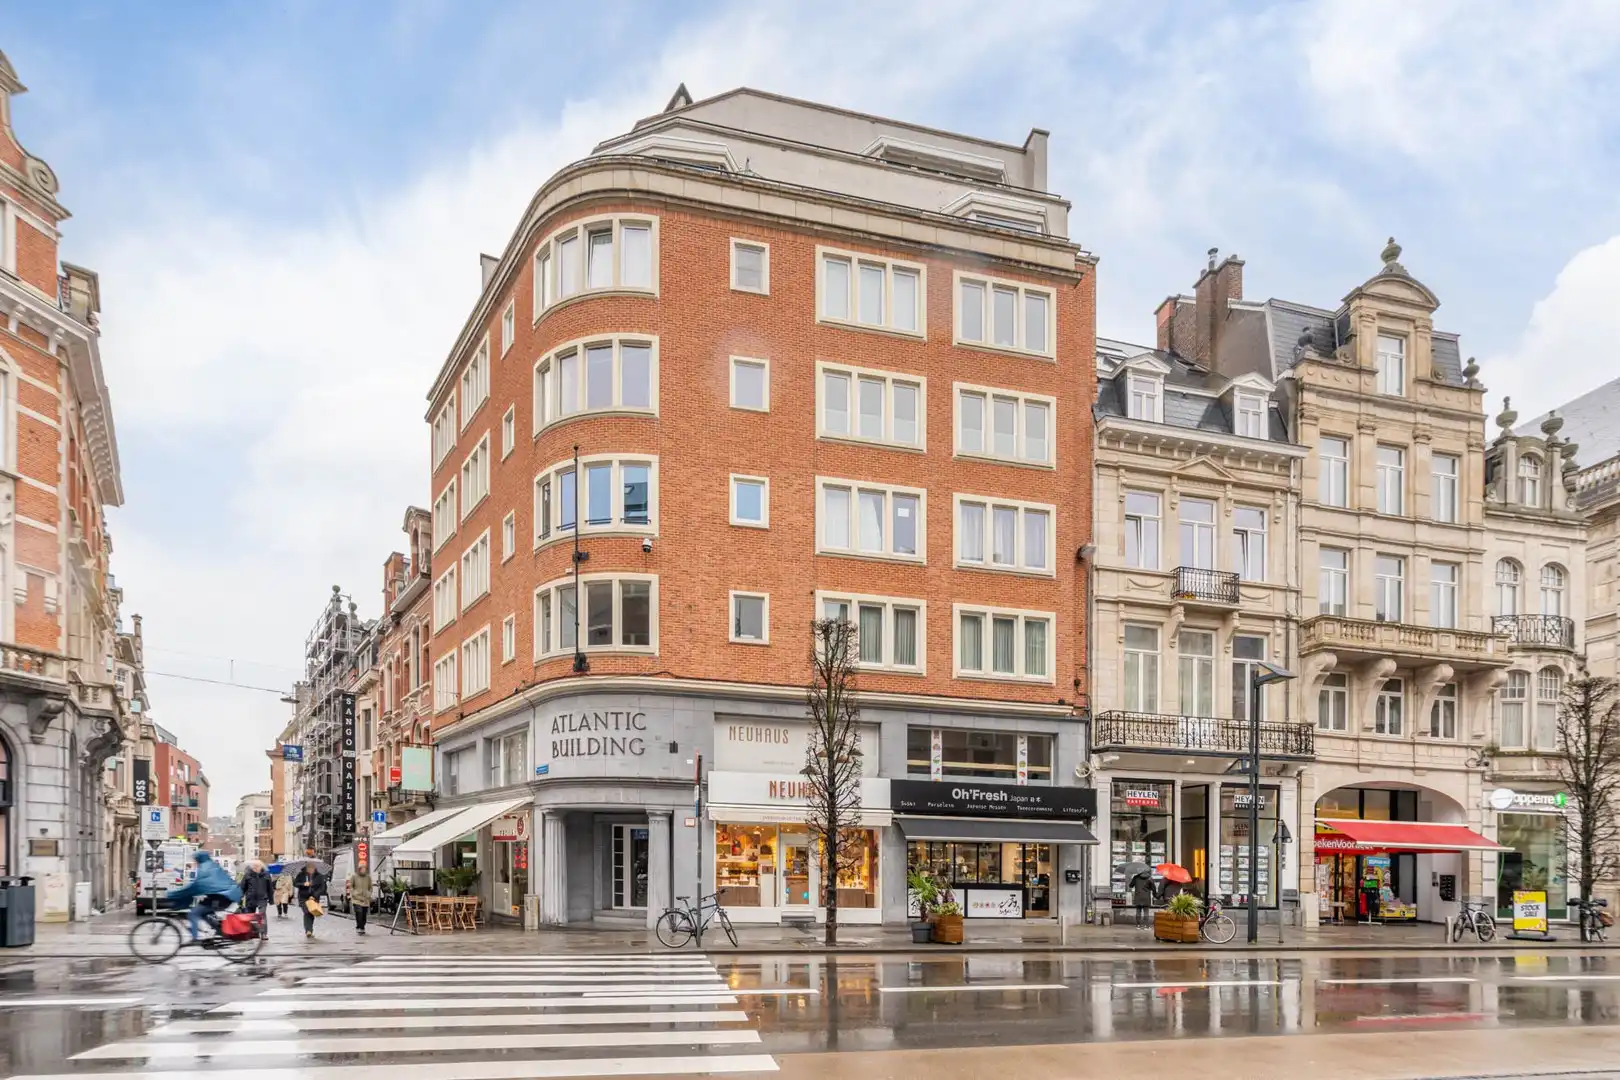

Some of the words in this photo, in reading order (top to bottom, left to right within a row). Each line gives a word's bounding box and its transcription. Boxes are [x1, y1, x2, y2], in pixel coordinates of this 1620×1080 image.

[551, 711, 647, 735] ATLANTIC
[729, 725, 789, 744] NEUHAUS
[551, 736, 646, 759] BUILDING
[1235, 795, 1264, 803] HEYN
